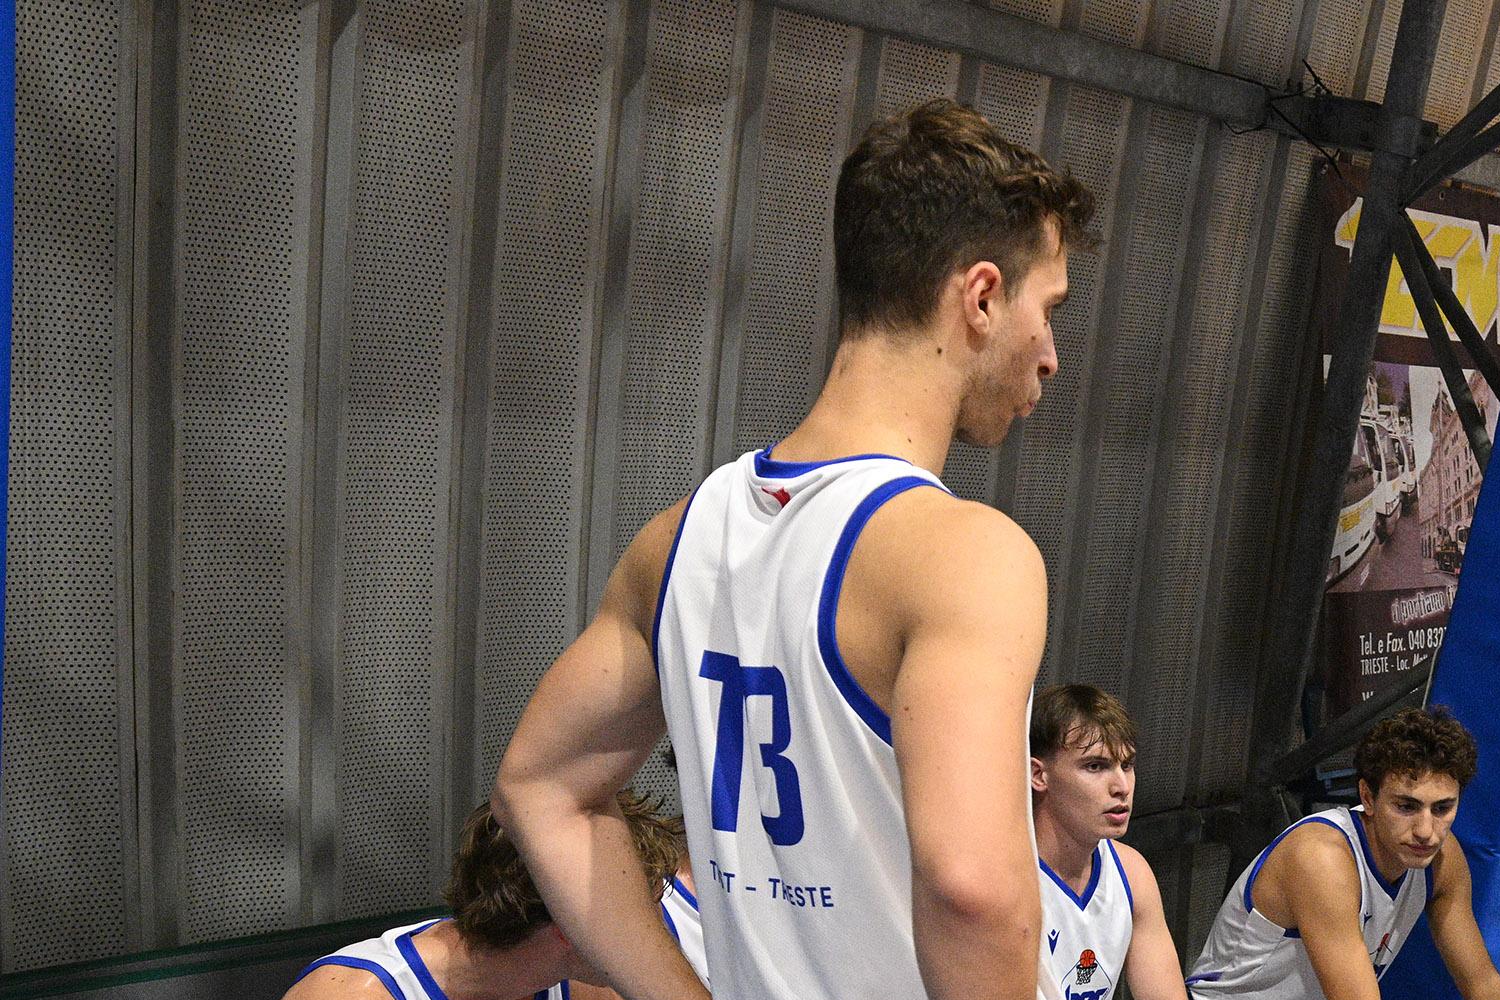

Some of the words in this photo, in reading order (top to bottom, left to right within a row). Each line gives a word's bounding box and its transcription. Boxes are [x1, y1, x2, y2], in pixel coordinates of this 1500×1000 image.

[1360, 632, 1376, 656] Tel.
[1377, 638, 1384, 654] e
[1386, 632, 1407, 653] Fax.
[1408, 629, 1425, 650] 040
[1360, 656, 1389, 676] TRIESTE
[1396, 655, 1410, 671] Loc.
